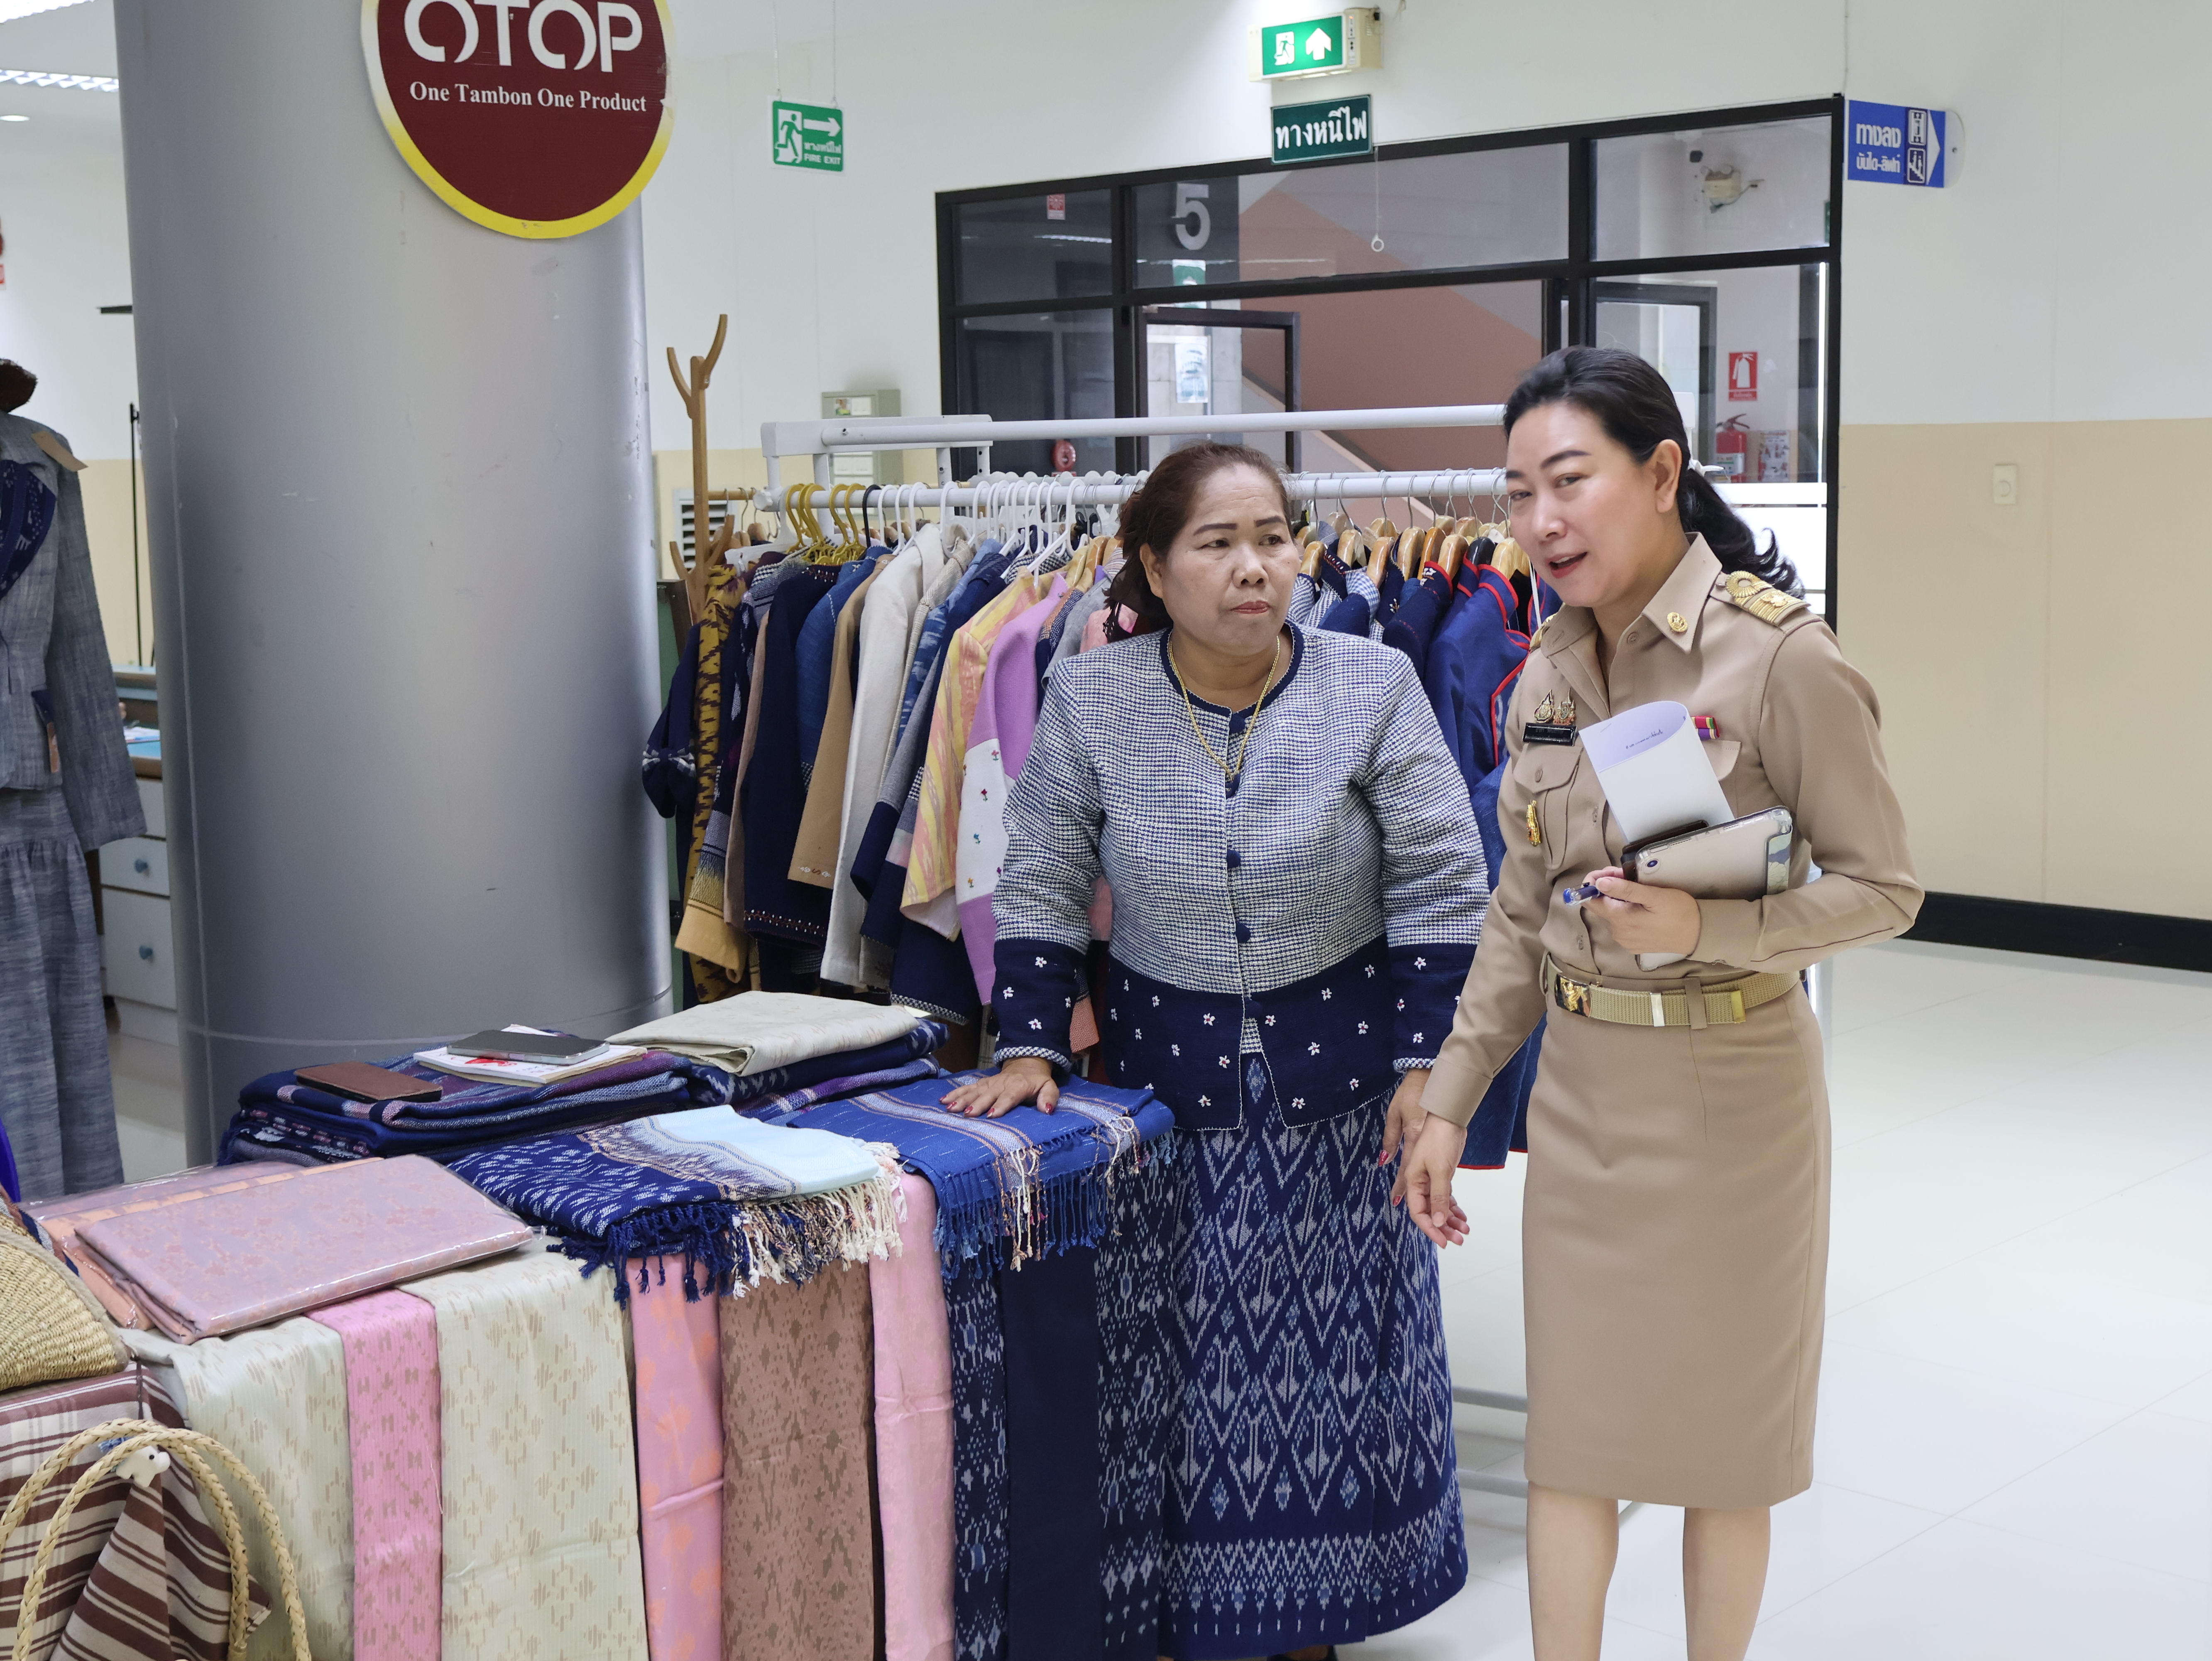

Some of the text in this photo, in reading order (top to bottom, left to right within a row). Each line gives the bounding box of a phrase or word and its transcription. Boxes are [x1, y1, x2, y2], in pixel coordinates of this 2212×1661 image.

[404, 0, 643, 72] OTOP
[409, 81, 647, 112] One Tambon One Product
[1275, 105, 1367, 149] ทางหนีไฟ
[1856, 123, 1901, 148] ทางลง
[804, 153, 841, 165] FIRE EXIT
[1170, 183, 1211, 250] 5
